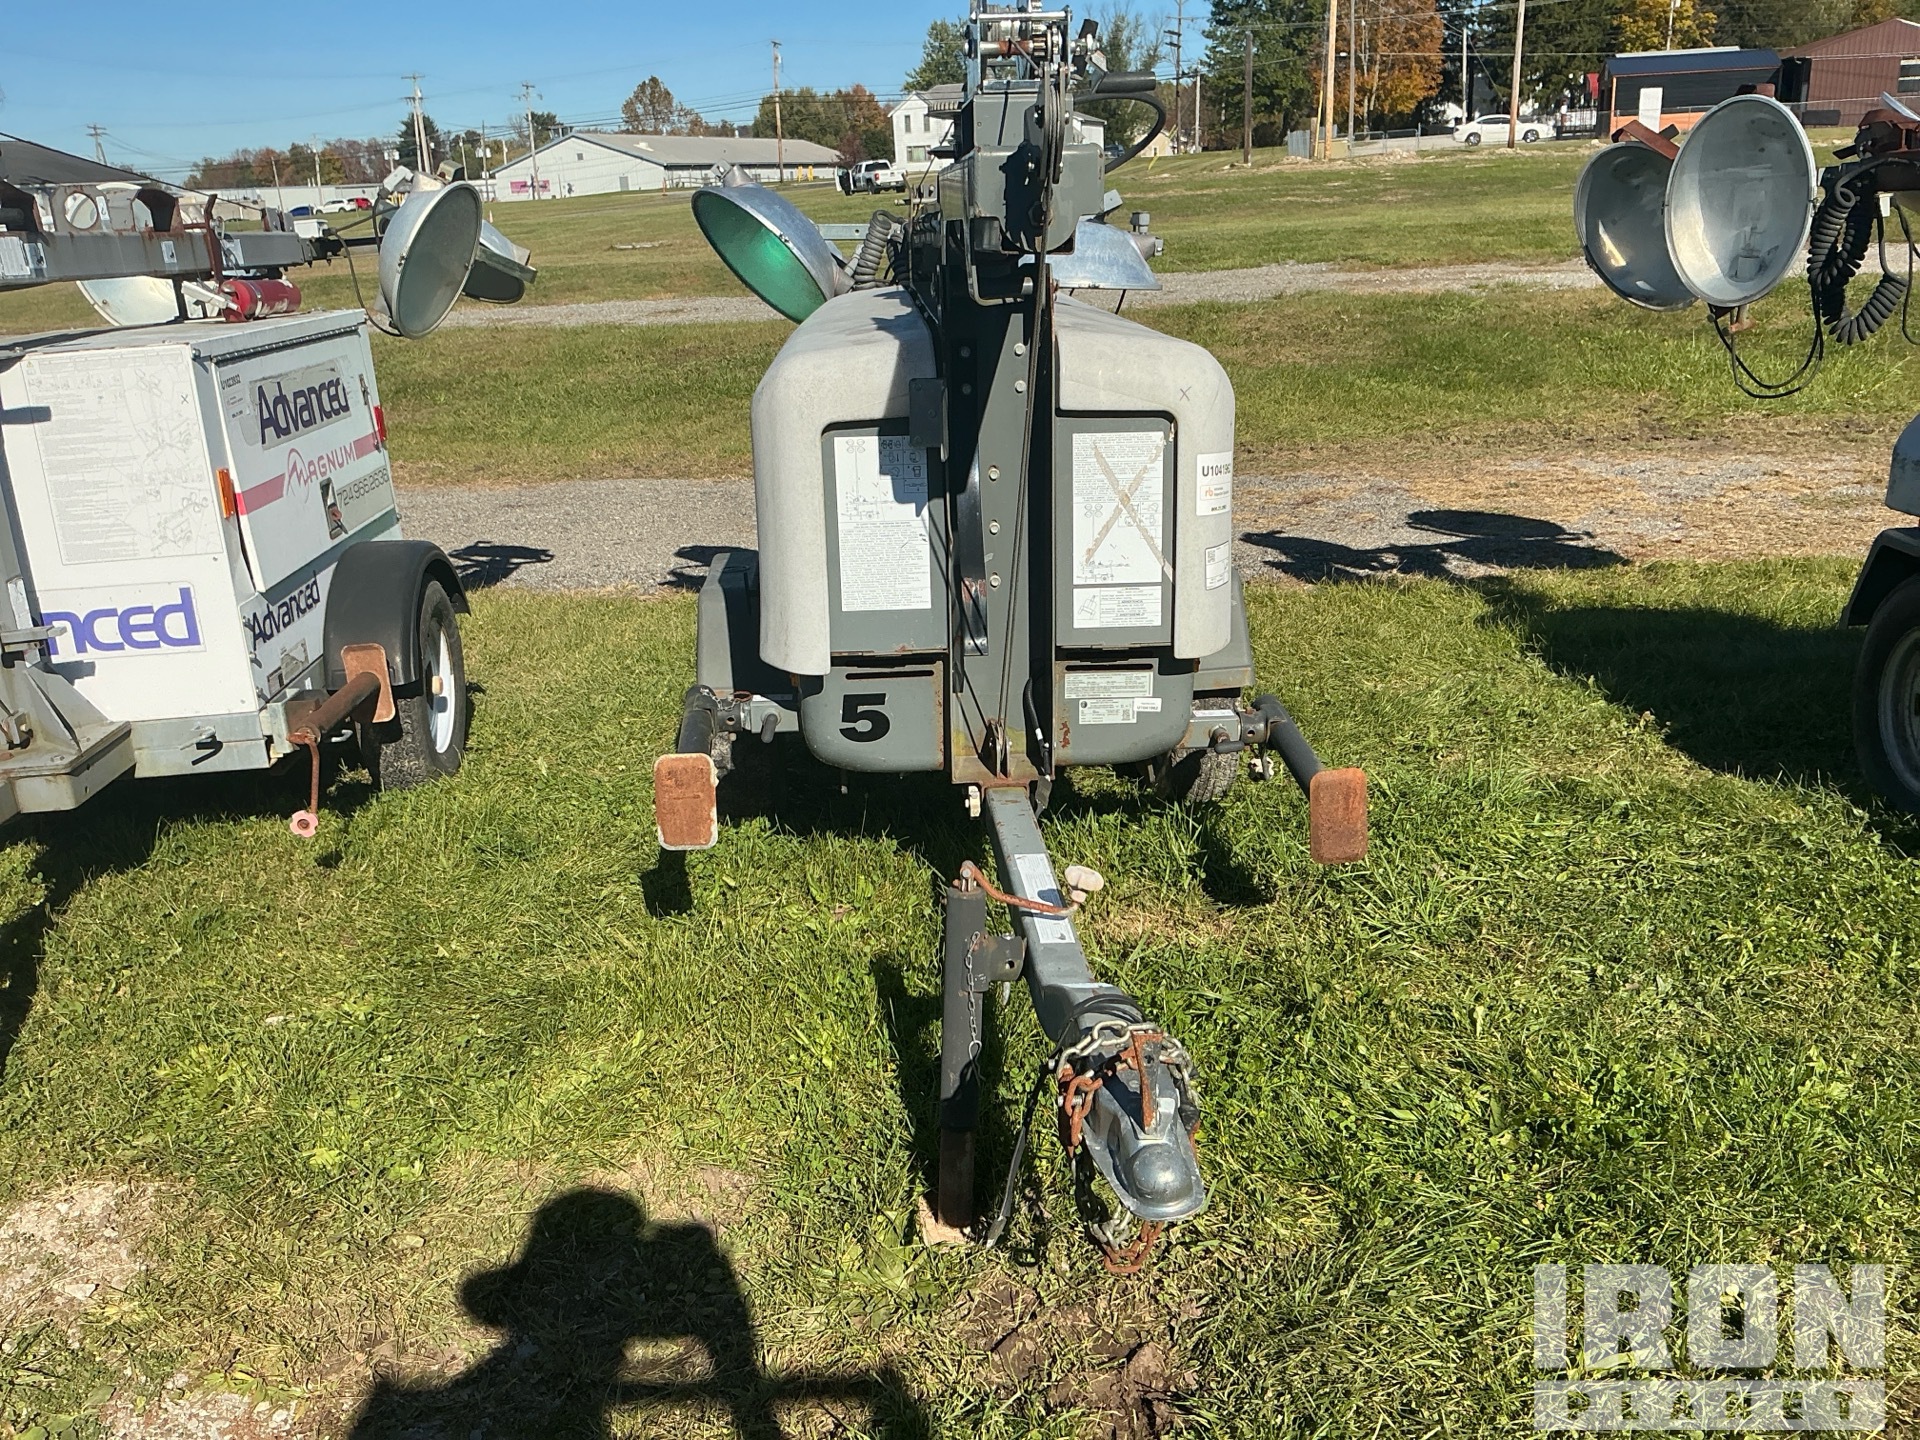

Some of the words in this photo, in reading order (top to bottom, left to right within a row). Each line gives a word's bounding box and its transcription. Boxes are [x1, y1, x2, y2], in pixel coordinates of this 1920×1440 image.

[257, 378, 350, 445] Advanced
[286, 442, 356, 504] MAGNUM
[41, 587, 201, 656] nced
[252, 570, 321, 651] Advanced
[839, 693, 890, 743] 5
